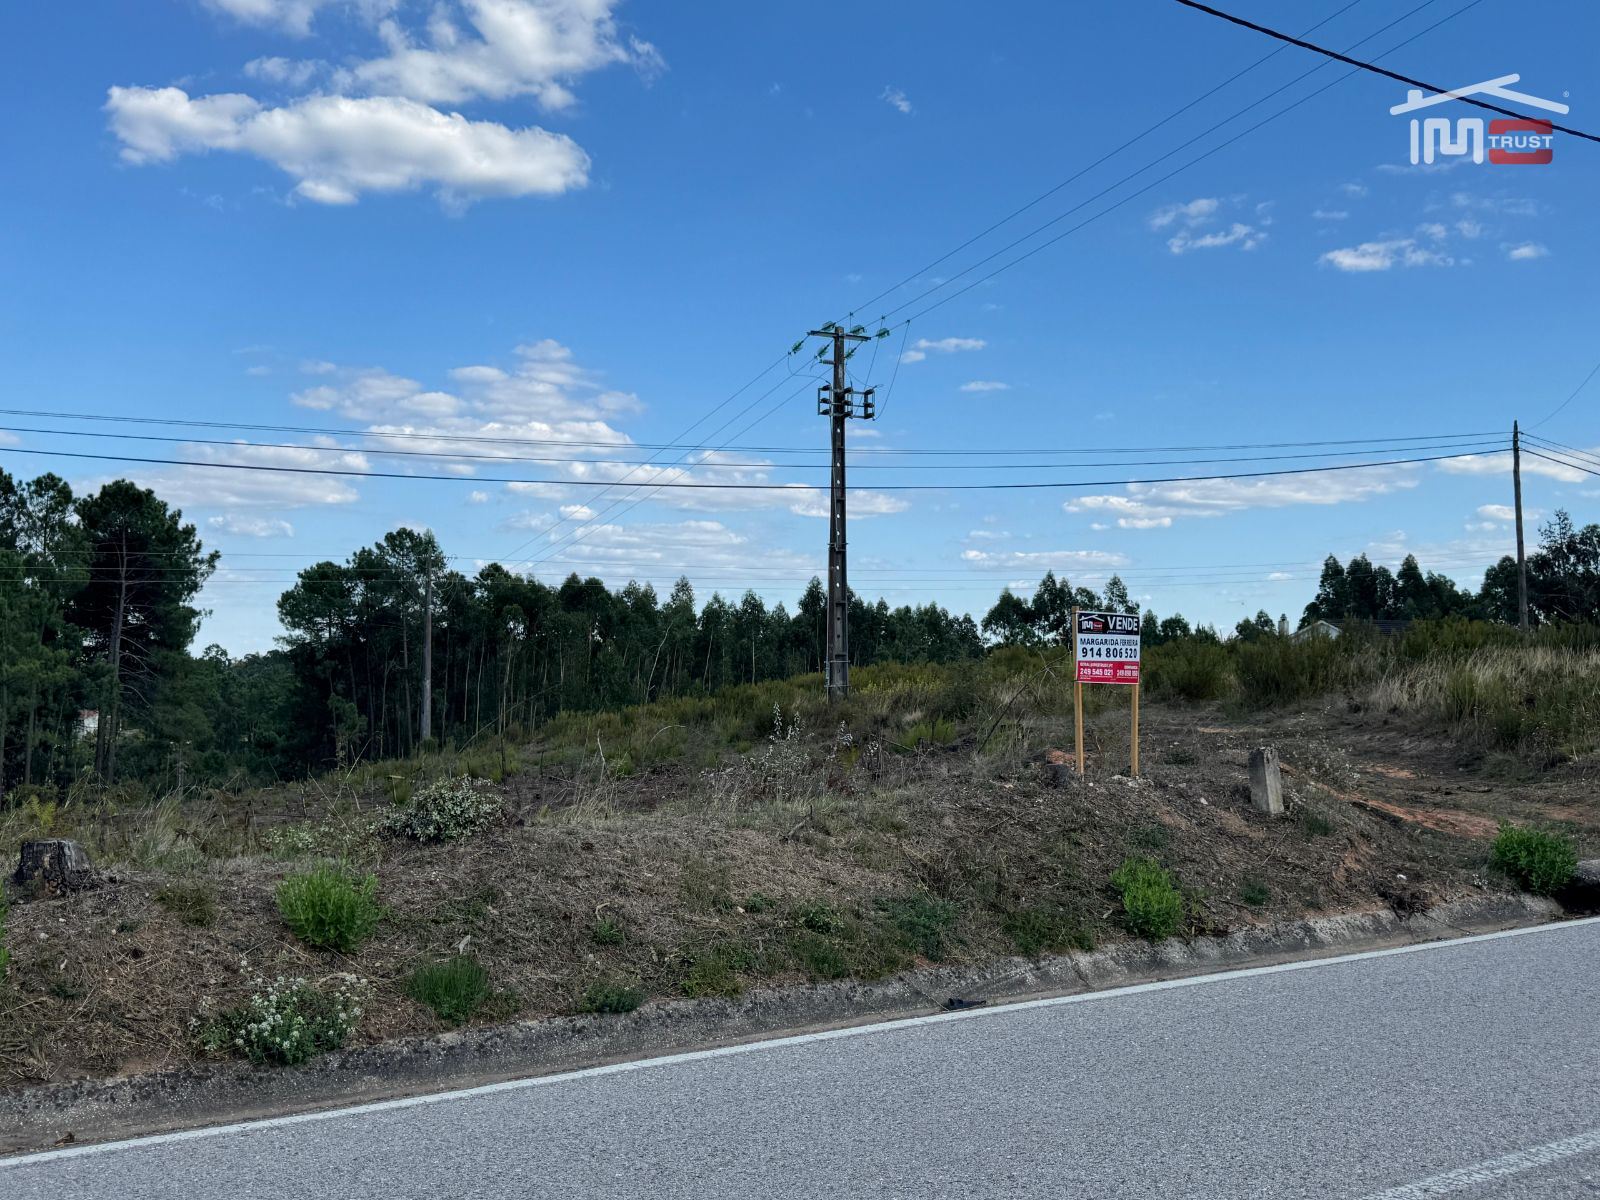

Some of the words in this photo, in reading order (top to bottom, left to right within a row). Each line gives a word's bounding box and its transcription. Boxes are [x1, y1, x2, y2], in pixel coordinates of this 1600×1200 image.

[1107, 616, 1138, 631] VENDE
[1080, 638, 1119, 646] MARGARIDA
[1082, 647, 1102, 658] 914
[1105, 647, 1123, 658] 806
[1124, 648, 1137, 658] 520
